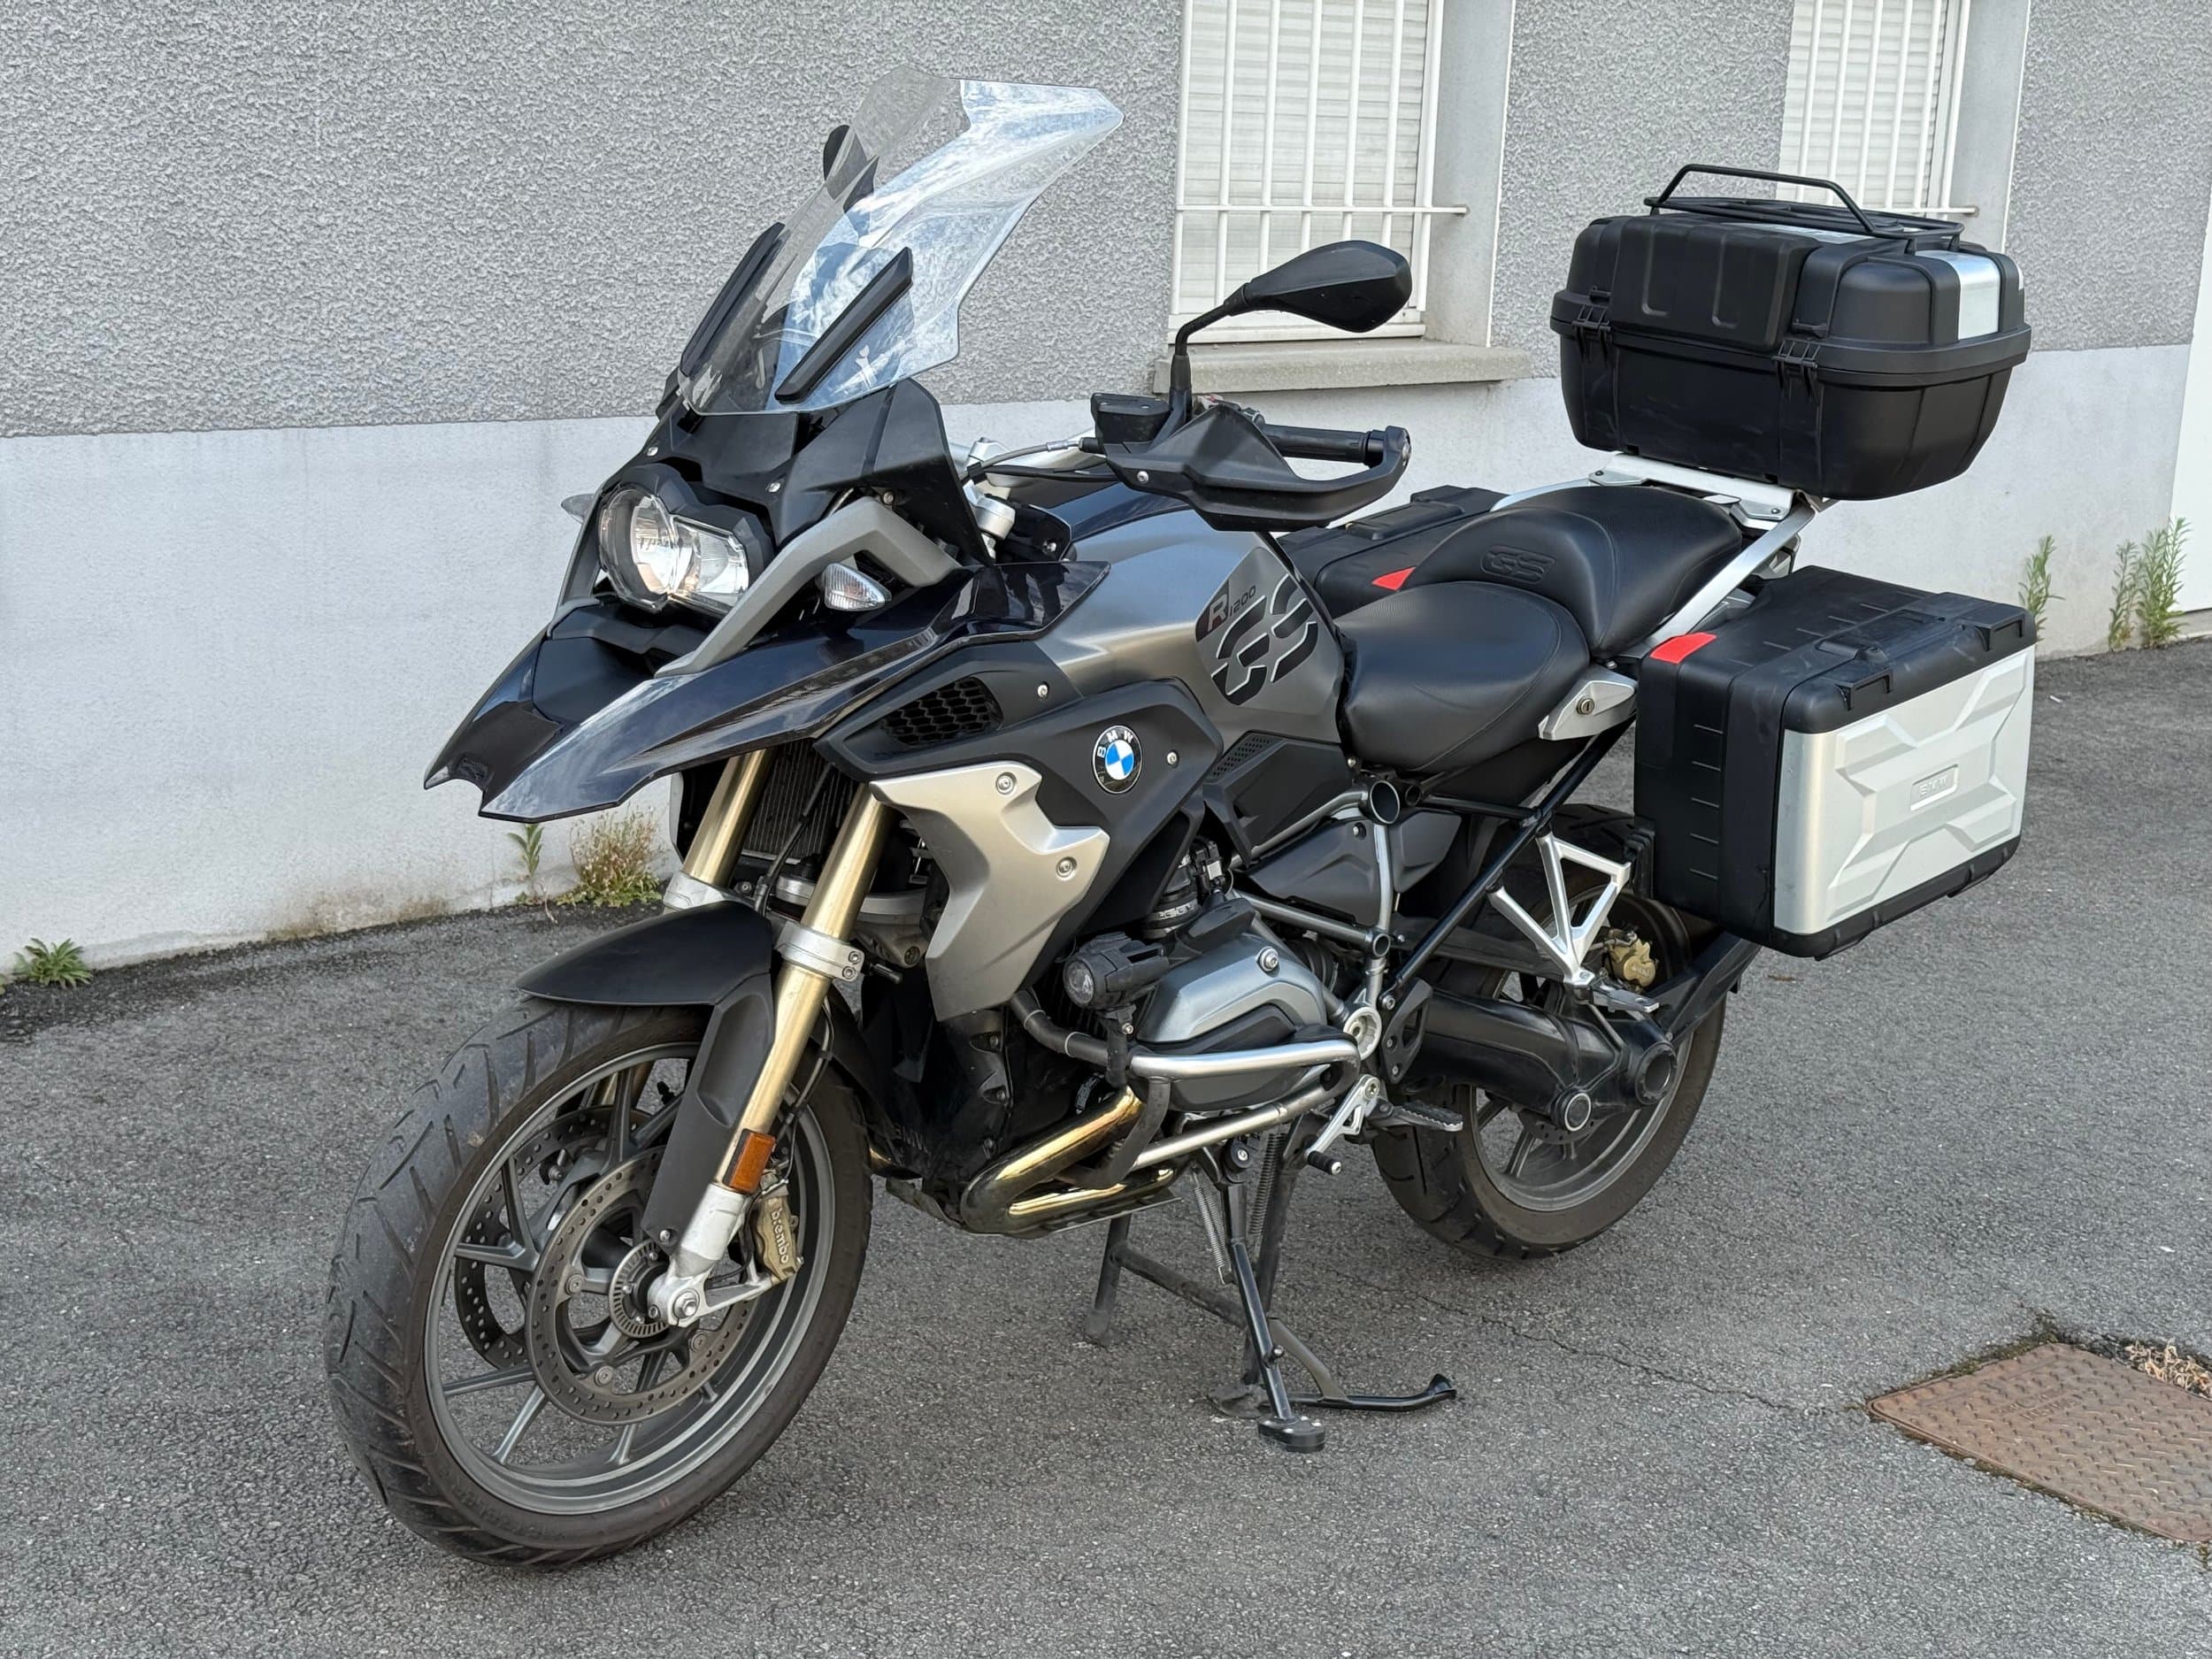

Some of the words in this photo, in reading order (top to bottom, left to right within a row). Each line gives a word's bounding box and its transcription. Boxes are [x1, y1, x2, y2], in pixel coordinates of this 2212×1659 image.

[1230, 585, 1256, 617] 1200
[1097, 729, 1134, 759] BMW
[772, 1207, 790, 1263] brembo
